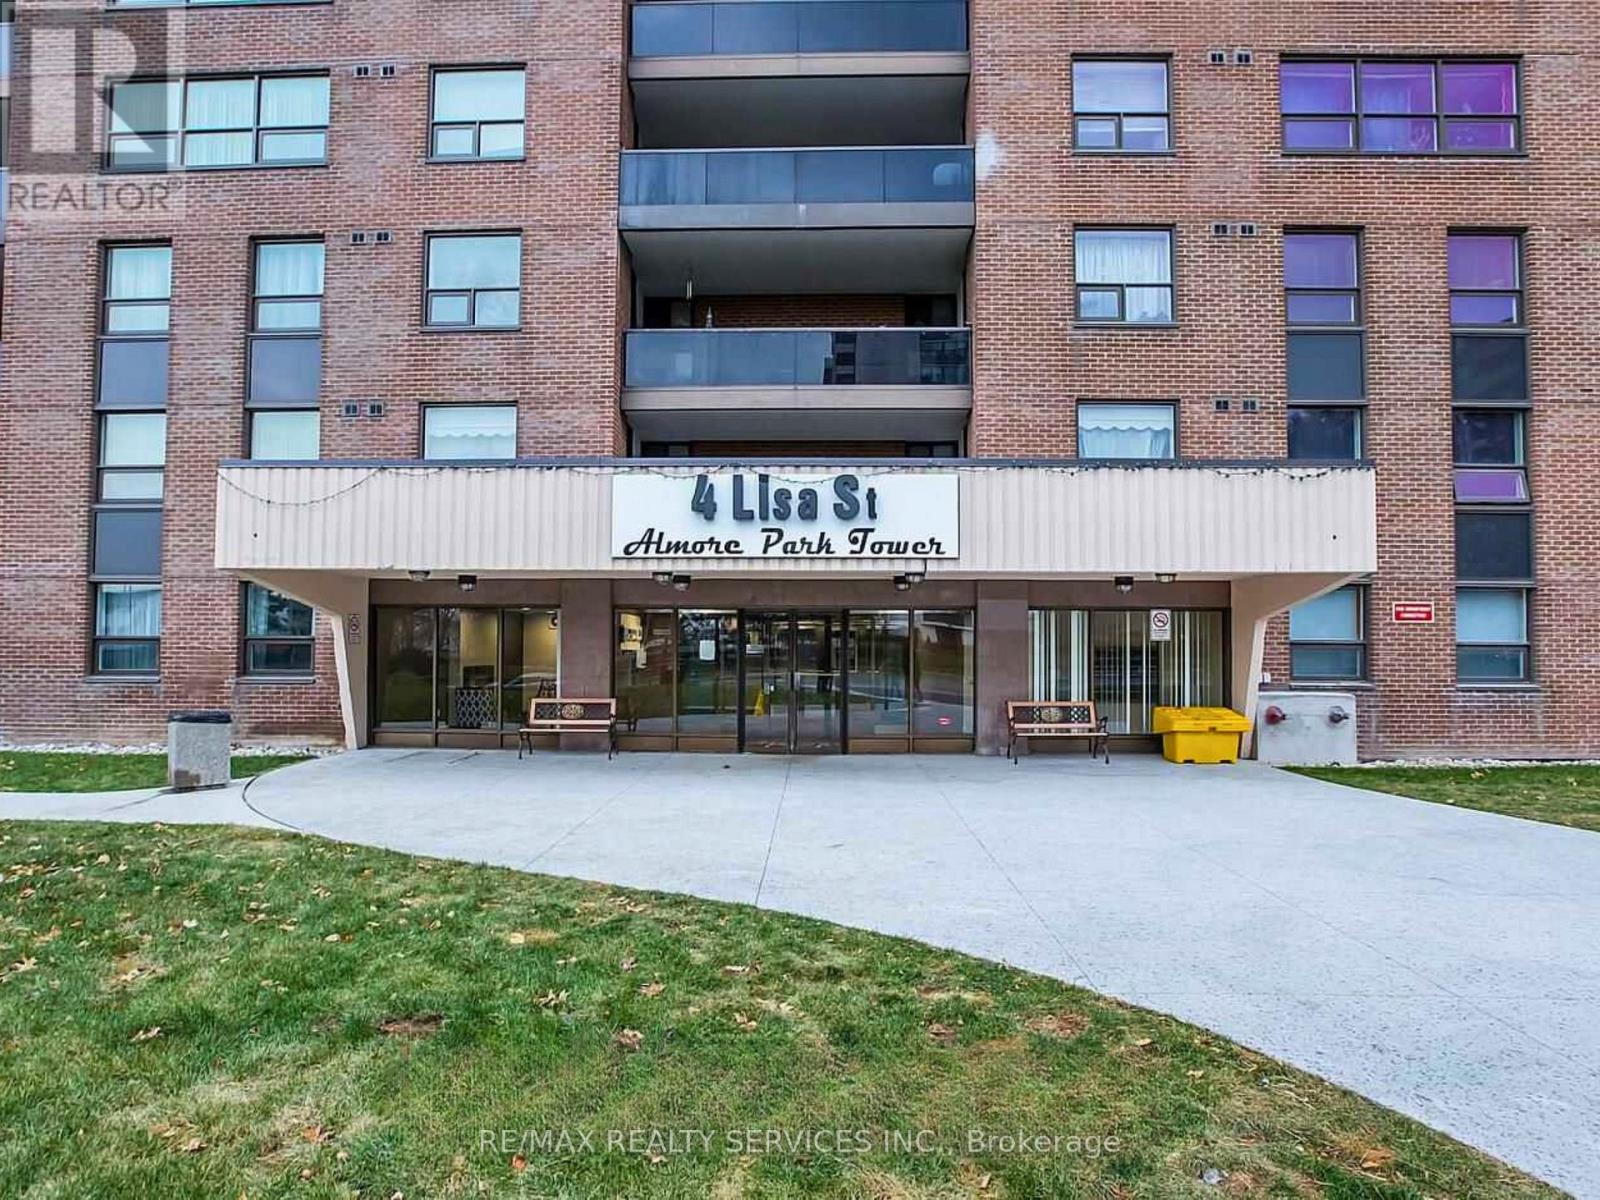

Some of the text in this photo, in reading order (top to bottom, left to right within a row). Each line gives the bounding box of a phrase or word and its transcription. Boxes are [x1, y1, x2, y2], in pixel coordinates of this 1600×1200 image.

[691, 474, 878, 520] 4 Lisa St
[623, 527, 946, 556] Almore Park Tower
